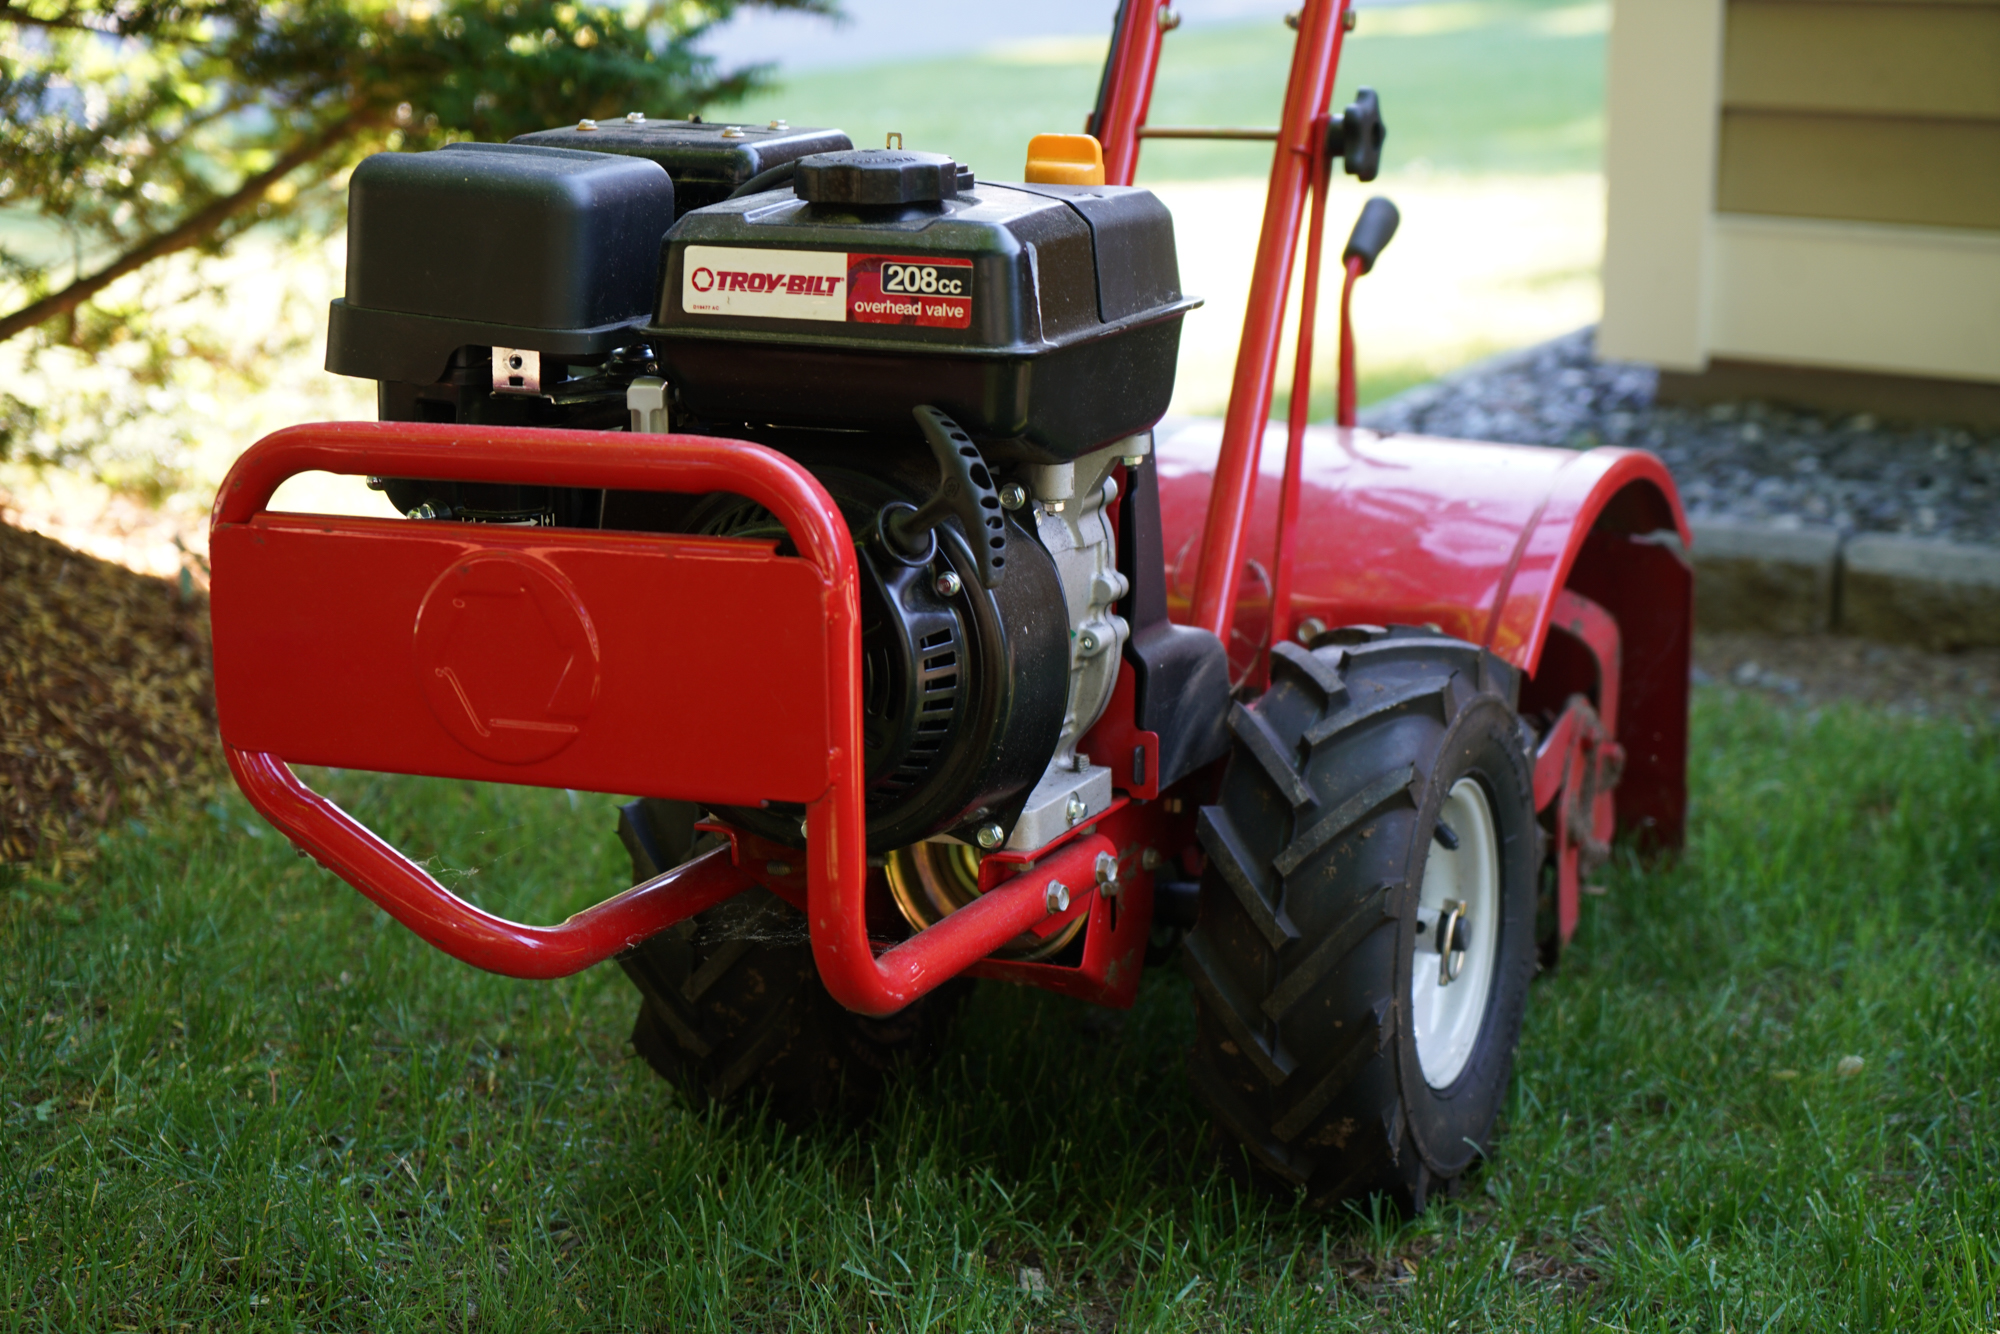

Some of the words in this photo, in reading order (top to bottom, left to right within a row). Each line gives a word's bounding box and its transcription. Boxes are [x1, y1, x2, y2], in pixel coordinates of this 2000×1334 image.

[716, 271, 841, 297] TROY-BILT
[886, 265, 962, 294] 208cc
[854, 299, 922, 316] overhead
[925, 303, 965, 318] valve
